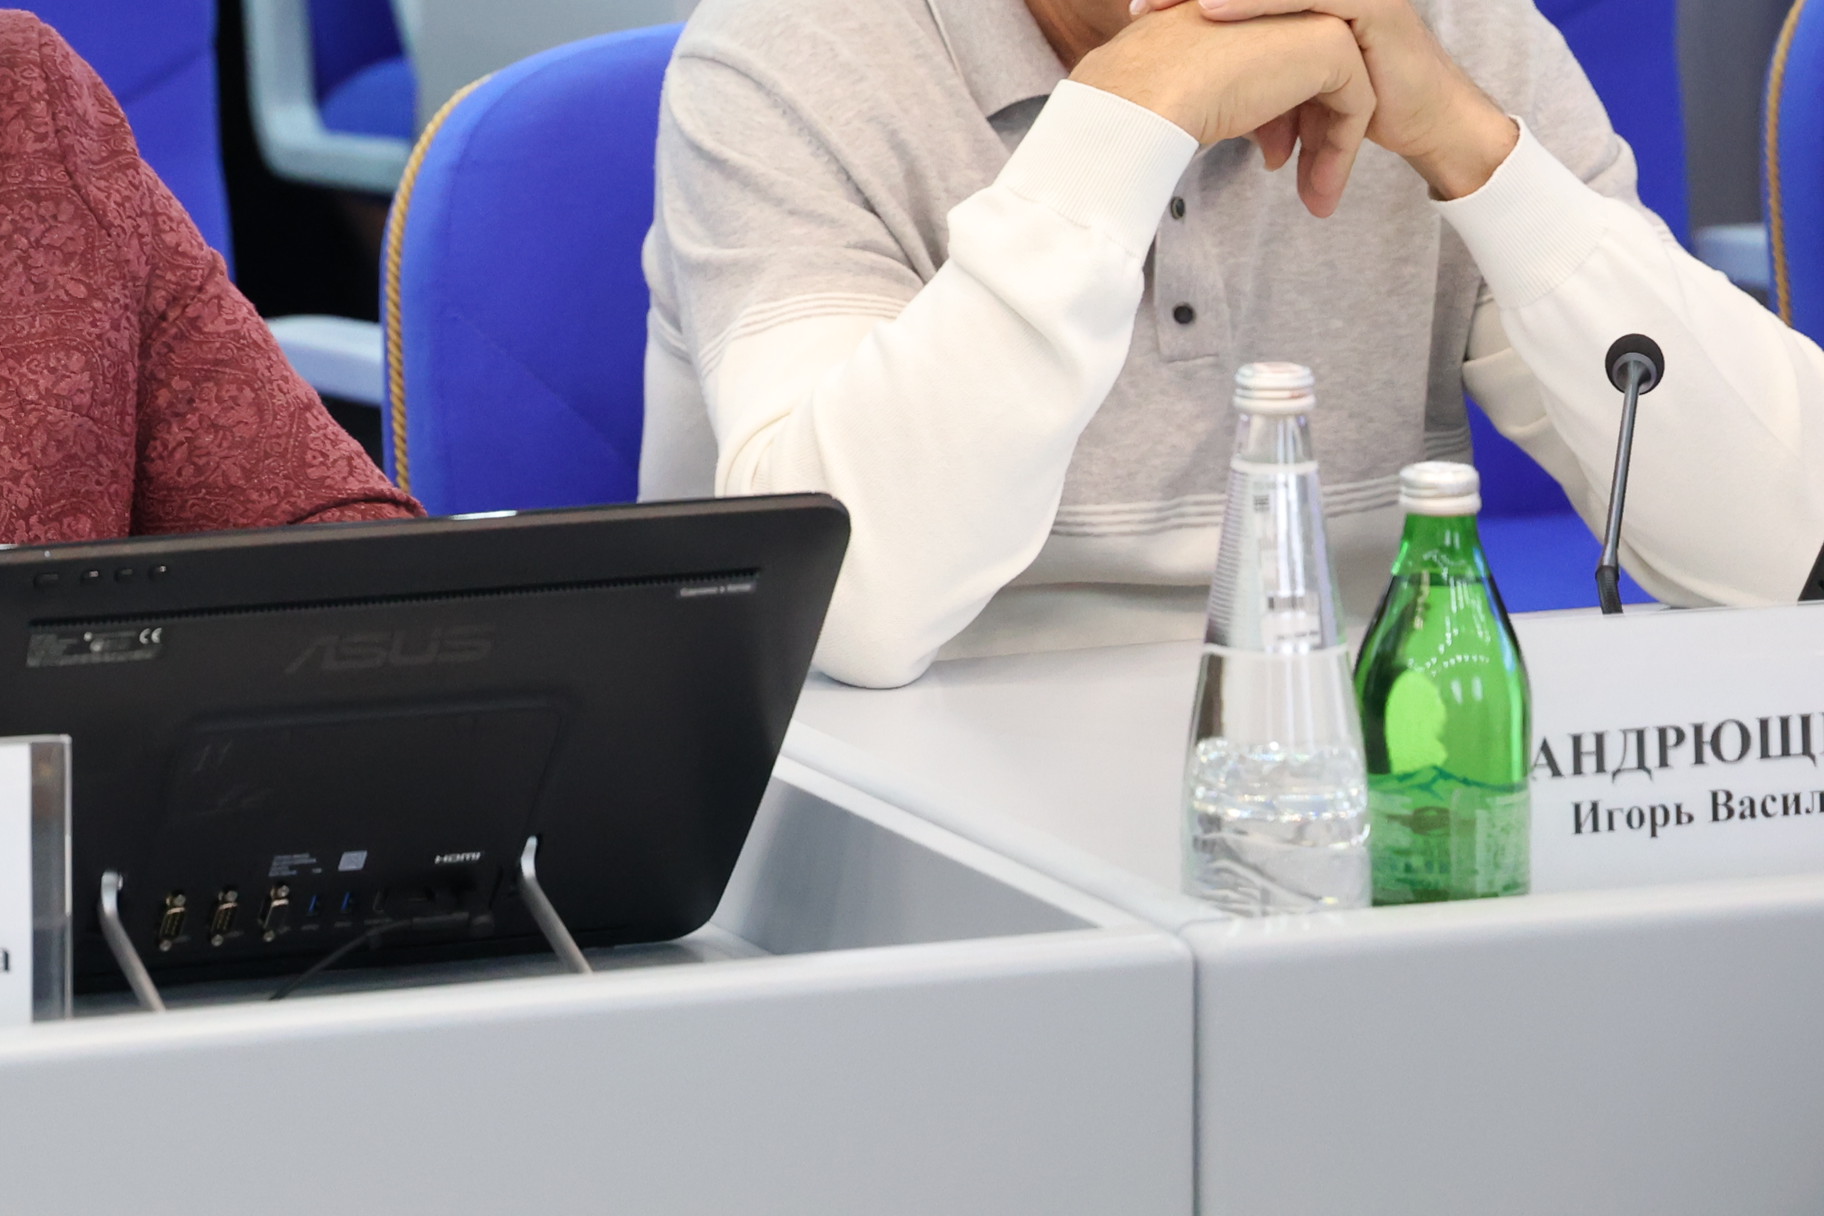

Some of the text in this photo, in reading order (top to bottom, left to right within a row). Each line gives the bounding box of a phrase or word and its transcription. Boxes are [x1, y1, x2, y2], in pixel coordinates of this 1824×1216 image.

[284, 623, 497, 675] ASUS
[1530, 711, 1824, 783] АНДРЮЩ
[1571, 798, 1696, 839] Игорь
